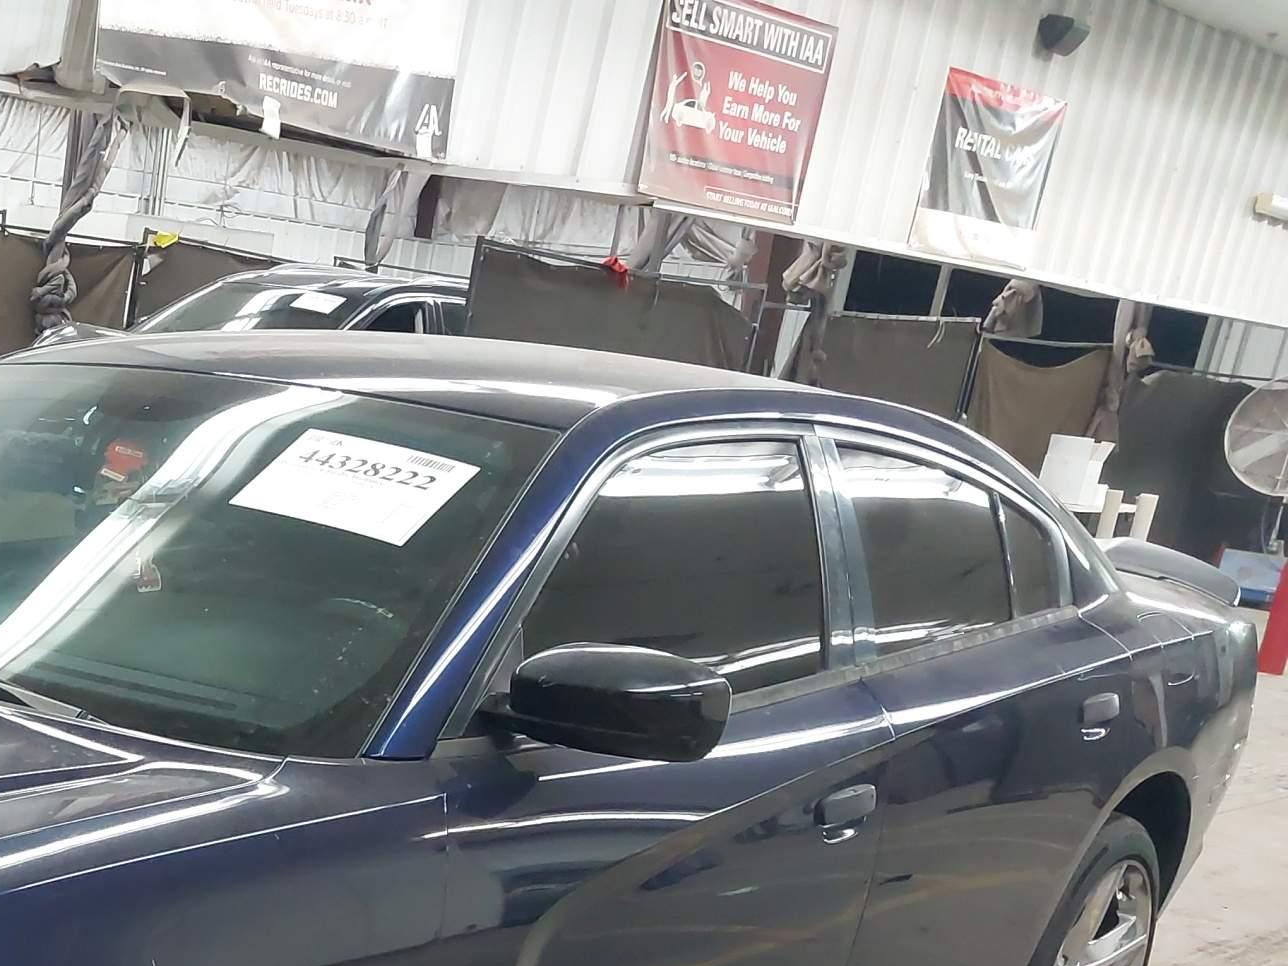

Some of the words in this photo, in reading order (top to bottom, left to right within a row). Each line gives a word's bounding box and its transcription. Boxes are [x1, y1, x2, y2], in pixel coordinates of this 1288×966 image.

[710, 8, 762, 46] SMART
[763, 22, 800, 58] WITH
[799, 36, 824, 66] IAA
[259, 72, 338, 109] RECRIDES.COM
[728, 71, 746, 92] We
[748, 76, 775, 102] Help
[778, 83, 798, 106] You
[722, 96, 749, 119] Earn
[751, 103, 780, 127] More
[782, 112, 801, 132] For
[719, 120, 745, 144] Your
[747, 129, 787, 154] Vehicle
[299, 449, 437, 491] 44328222
